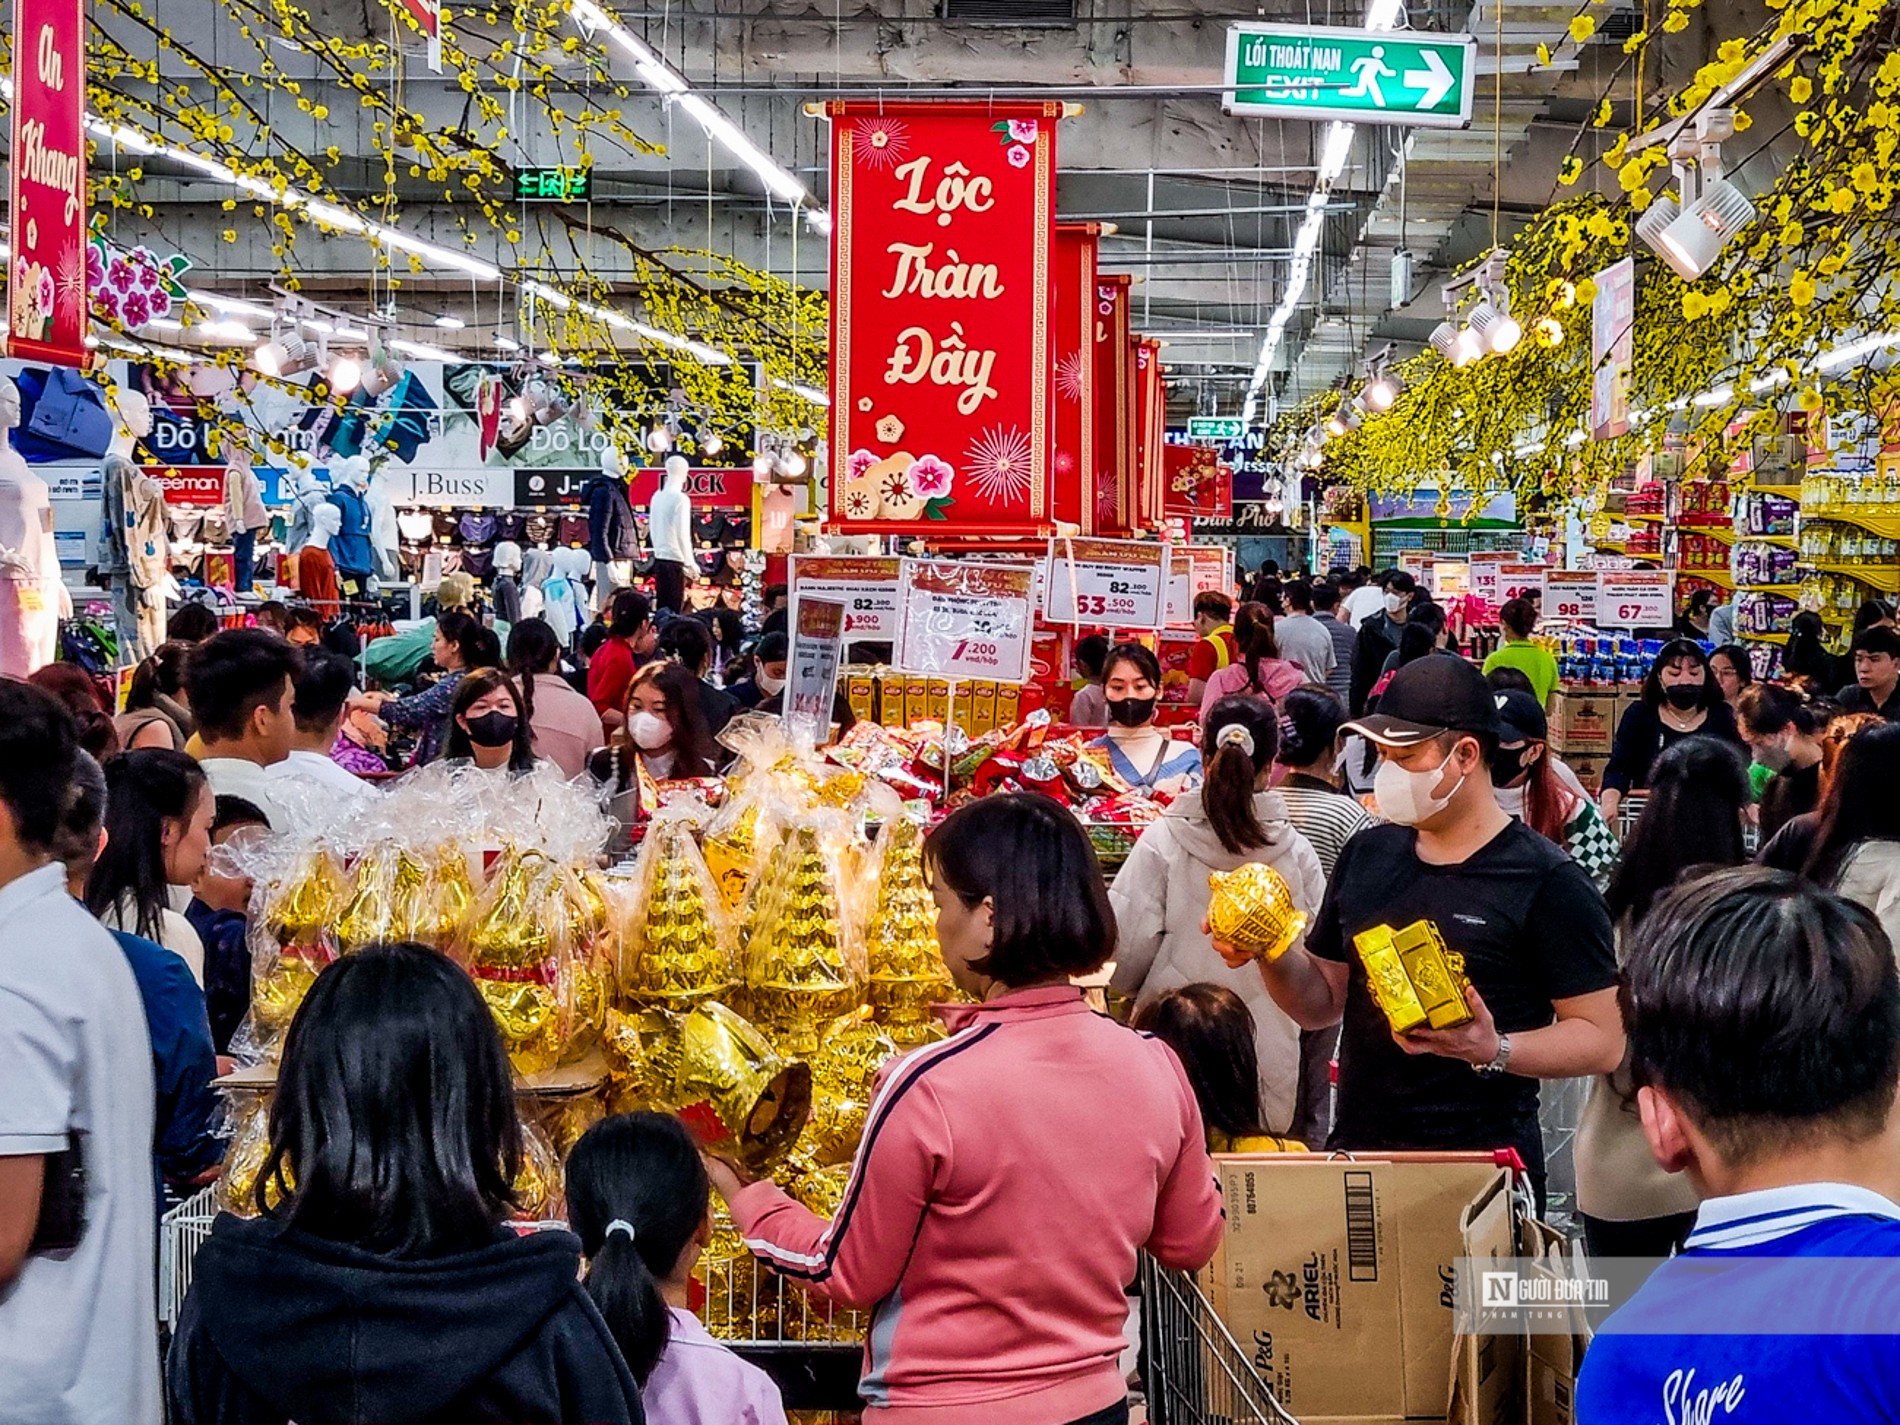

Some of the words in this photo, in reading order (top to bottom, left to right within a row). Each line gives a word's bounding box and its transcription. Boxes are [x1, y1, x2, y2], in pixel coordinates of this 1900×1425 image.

[38, 23, 64, 92] An
[1270, 40, 1309, 71] THOÁT
[1312, 48, 1342, 75] NẠN
[1265, 74, 1325, 100] EXIT
[21, 118, 79, 227] Khang
[892, 156, 995, 227] Lộc
[881, 242, 1005, 299] Tràn
[883, 321, 998, 416] Đầy
[155, 418, 196, 450] Đồ
[529, 419, 570, 451] Đồ
[407, 473, 486, 502] J.Buss
[1303, 1255, 1322, 1321] ARIEL
[1438, 1264, 1459, 1311] P&G
[1253, 1329, 1274, 1372] P&G
[1662, 1366, 1746, 1425] Share
